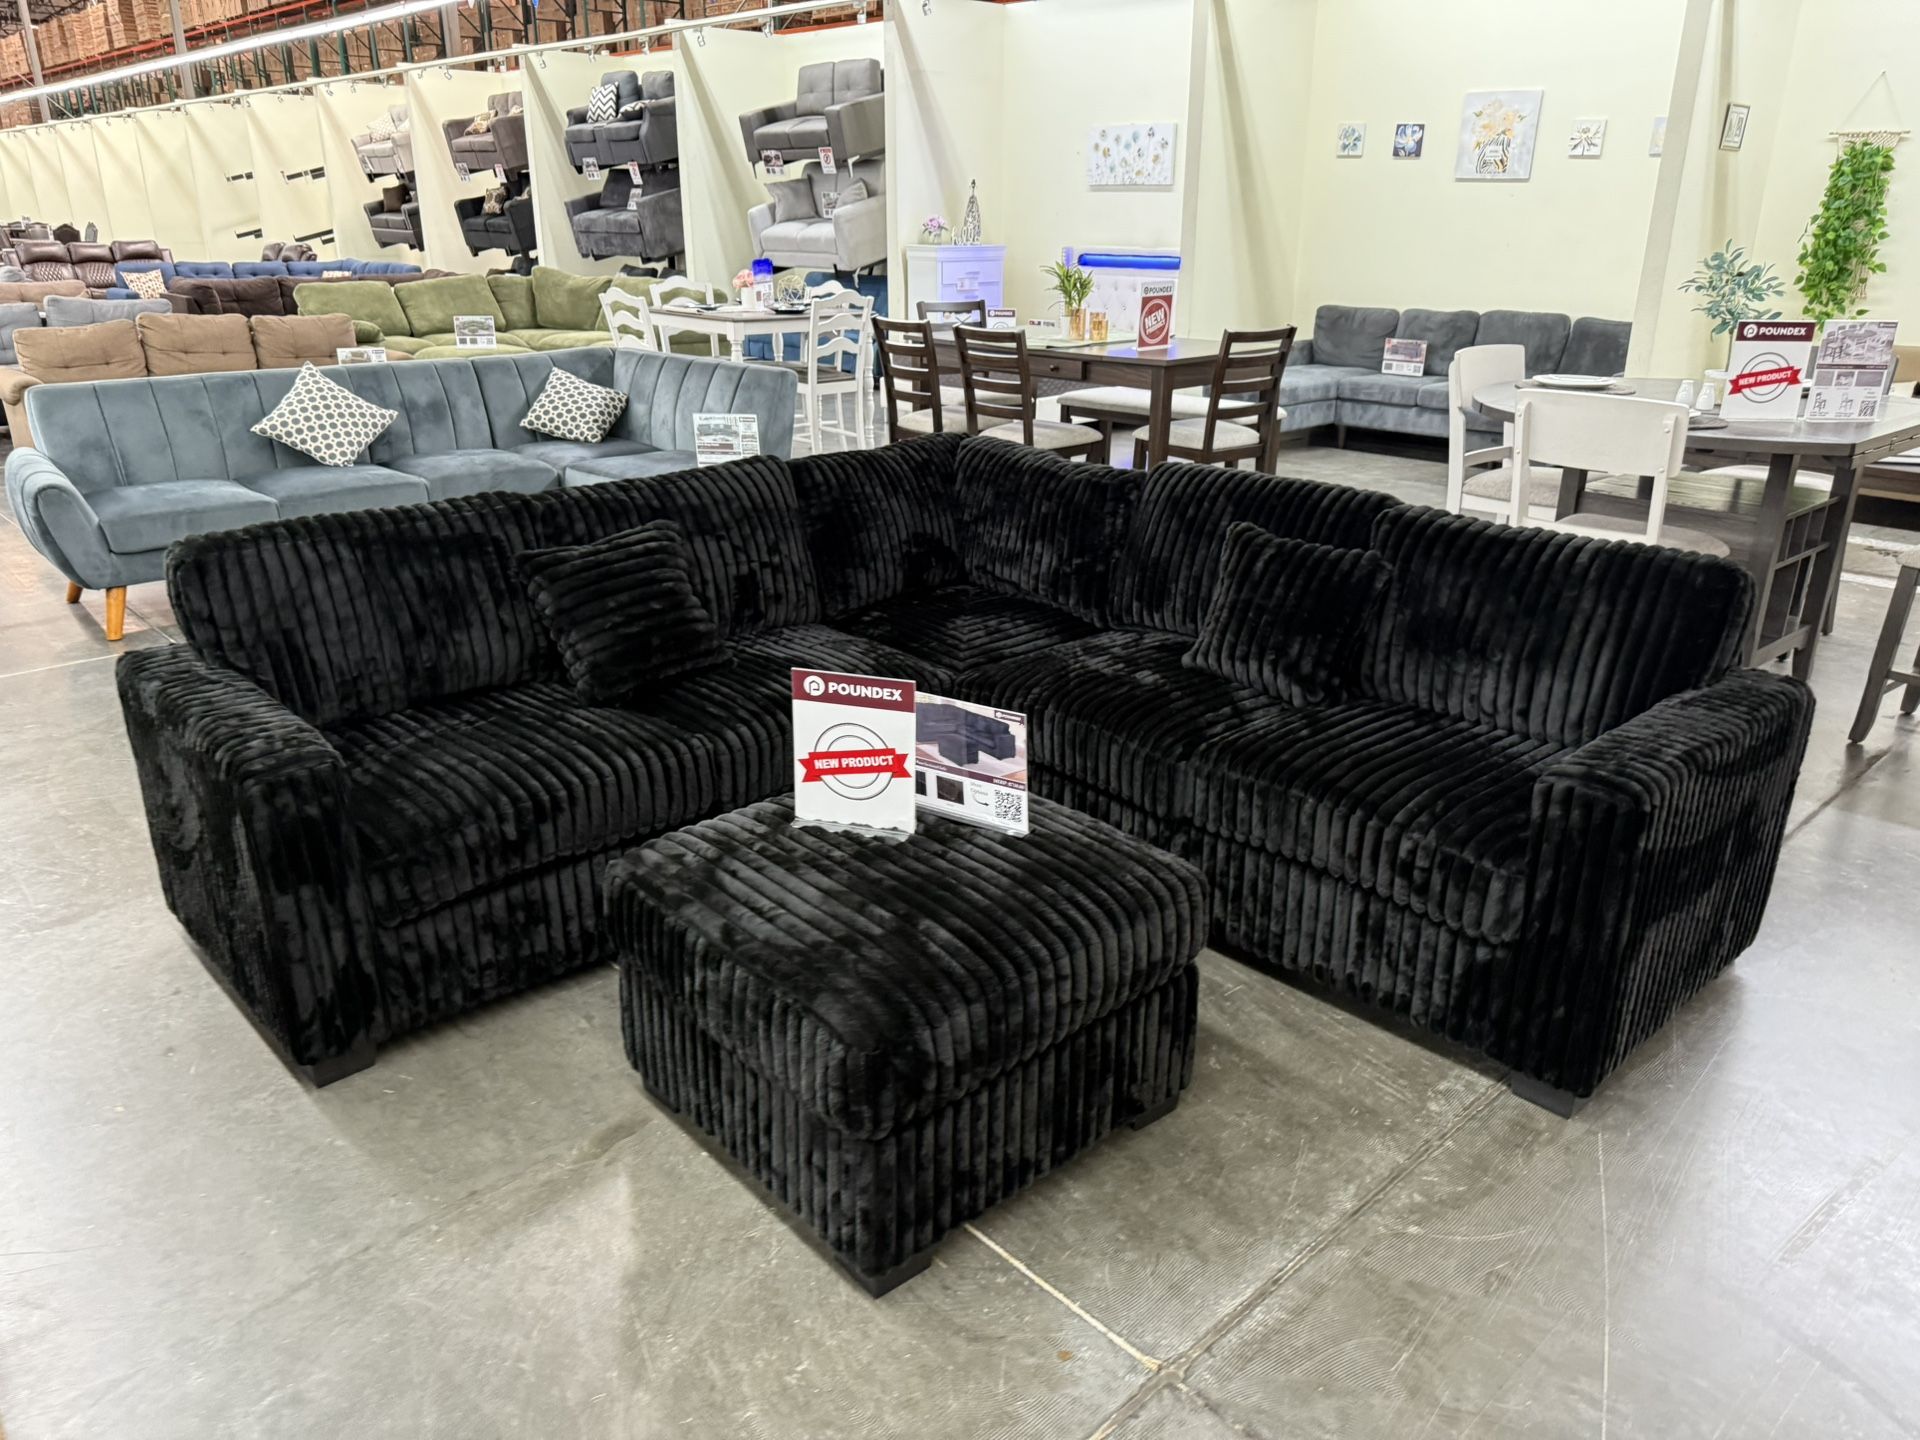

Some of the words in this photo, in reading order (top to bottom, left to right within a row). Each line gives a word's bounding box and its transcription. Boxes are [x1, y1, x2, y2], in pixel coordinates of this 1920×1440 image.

[1144, 307, 1166, 329] NEW
[1759, 326, 1807, 336] POUNDEX
[1738, 375, 1756, 387] NEW
[1756, 370, 1793, 384] PRODUCT
[828, 681, 903, 702] POUNDEX
[813, 757, 841, 770] NEW
[841, 754, 895, 769] PRODUCT
